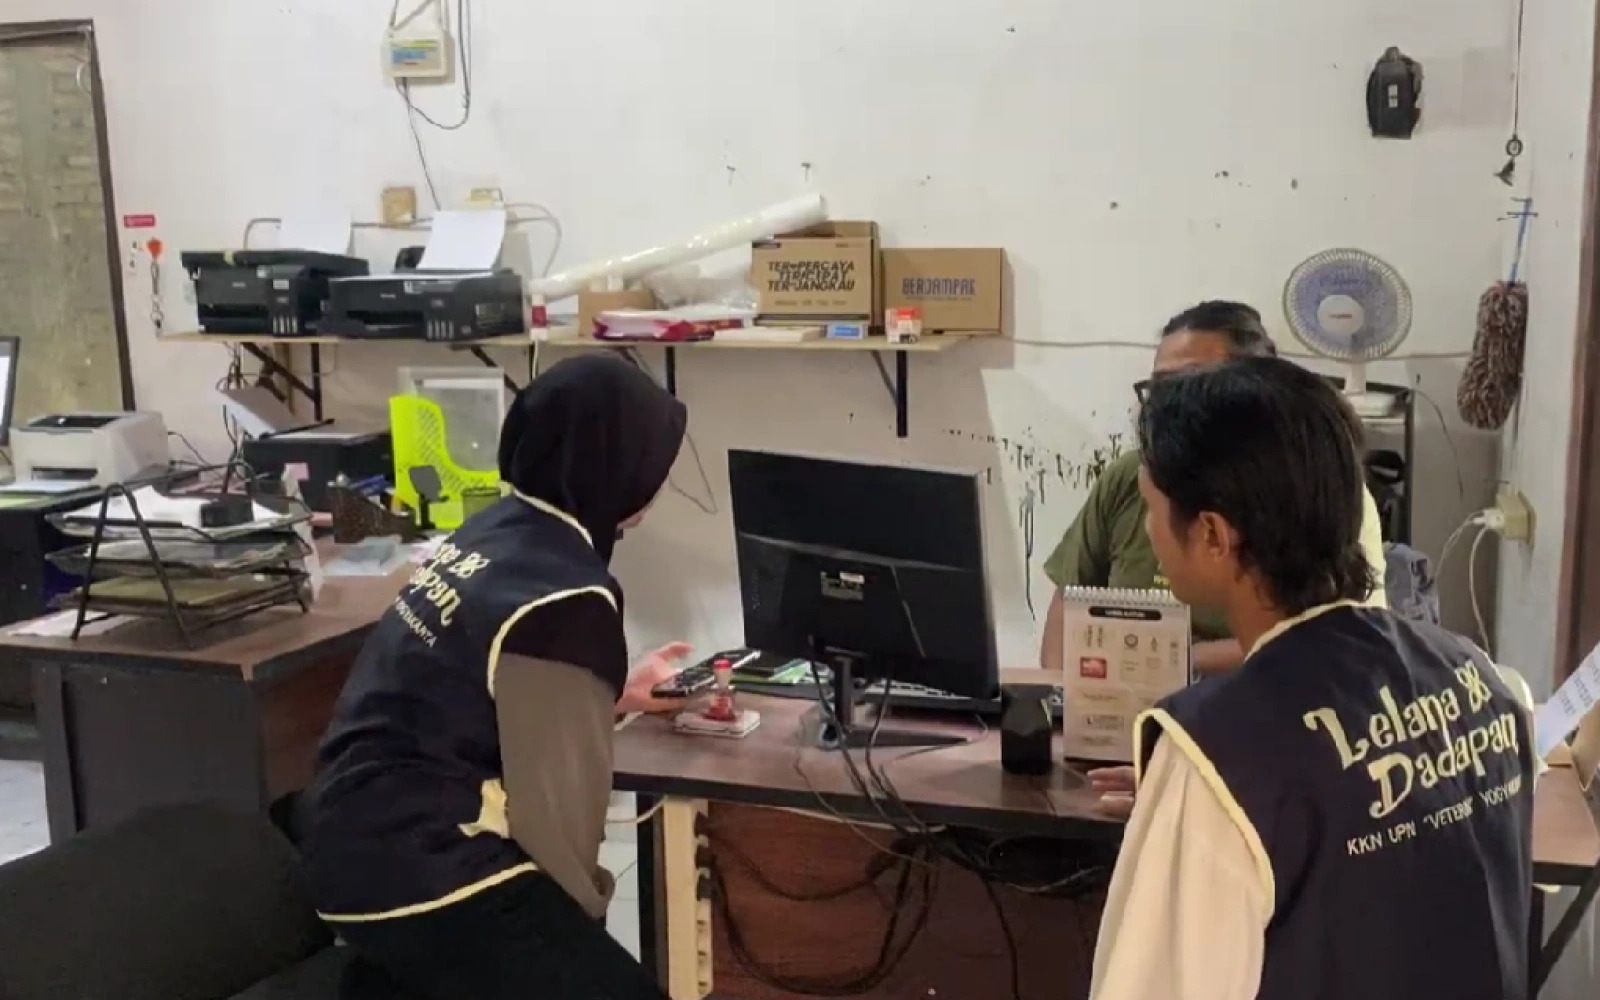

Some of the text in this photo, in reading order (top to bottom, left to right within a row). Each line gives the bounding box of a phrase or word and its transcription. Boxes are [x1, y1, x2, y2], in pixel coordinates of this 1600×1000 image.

[1302, 685, 1461, 770] Lelana
[1367, 713, 1519, 819] Dadapan
[1346, 831, 1383, 856] KKN
[1388, 820, 1417, 844] UPN
